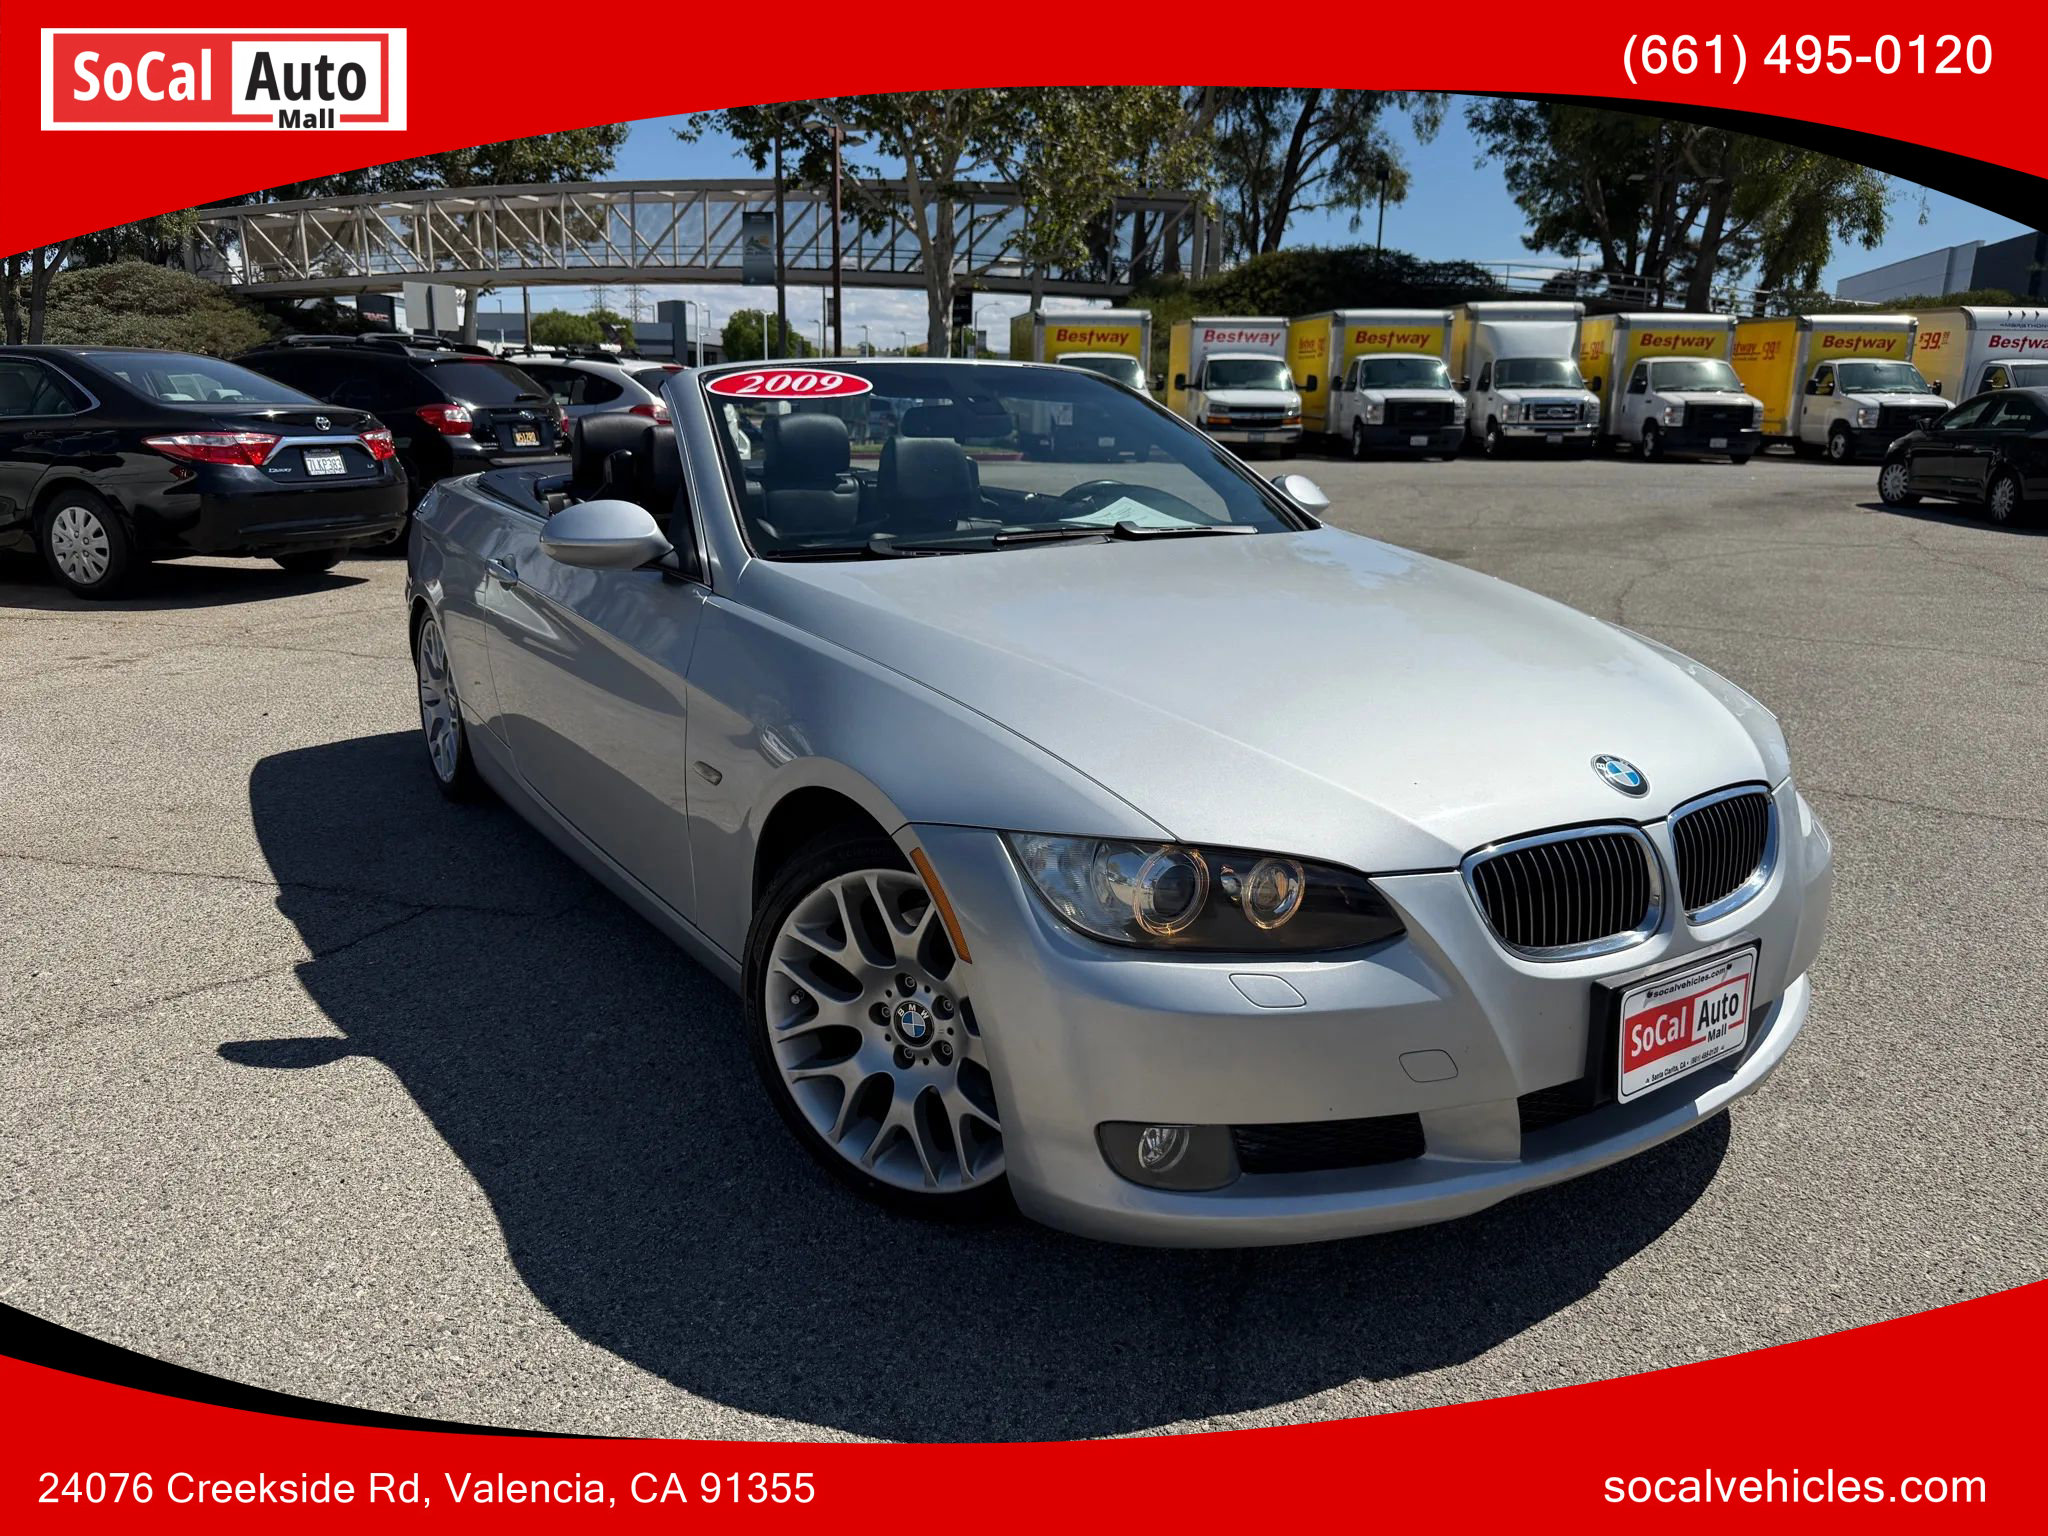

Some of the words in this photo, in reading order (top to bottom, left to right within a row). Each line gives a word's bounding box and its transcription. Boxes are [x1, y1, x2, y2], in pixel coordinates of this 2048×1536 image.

[1056, 328, 1130, 346] Bestway
[1203, 328, 1281, 346] Bestway
[1355, 330, 1431, 348] Bestway
[1640, 333, 1716, 350] Bestway
[1821, 335, 1897, 351] Bestway
[1988, 335, 2048, 352] Bestwa
[736, 374, 843, 394] 2009
[1653, 967, 1727, 997] socalvehicles.com
[897, 1003, 929, 1020] BMW
[1631, 1006, 1687, 1058] SoCal
[1697, 992, 1739, 1032] Auto
[1707, 1023, 1727, 1043] Mall
